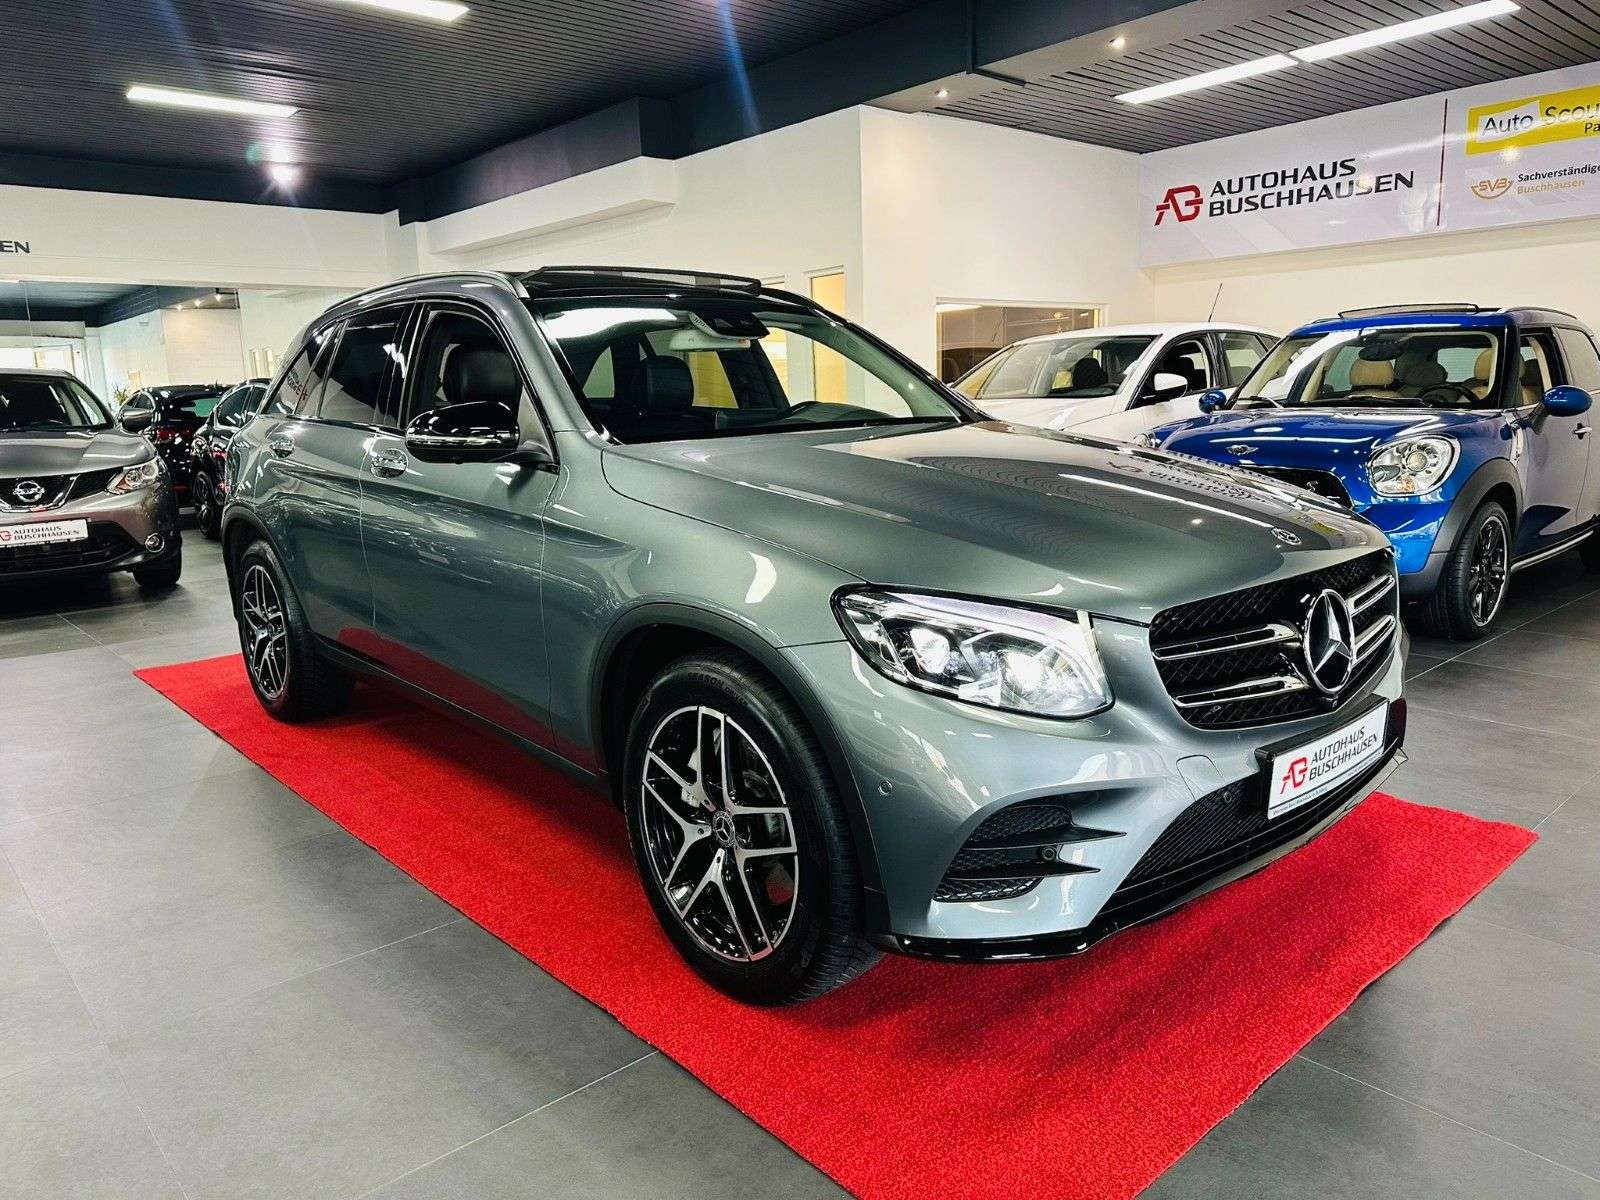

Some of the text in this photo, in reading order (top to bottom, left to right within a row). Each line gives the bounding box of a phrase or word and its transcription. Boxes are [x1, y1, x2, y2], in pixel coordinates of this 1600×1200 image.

[1482, 114, 1534, 136] Auto
[1210, 158, 1357, 197] AUTOHAUS
[1517, 179, 1585, 195] Buschhausen
[1209, 171, 1415, 217] BUSCHHAUSEN
[0, 240, 31, 254] EN
[13, 525, 62, 535] AUTOHAUS
[14, 530, 80, 541] BUSCHHAUSEN
[1311, 725, 1366, 765] AUTOHAUS
[1308, 733, 1378, 781] BUSCHHAUSEN
